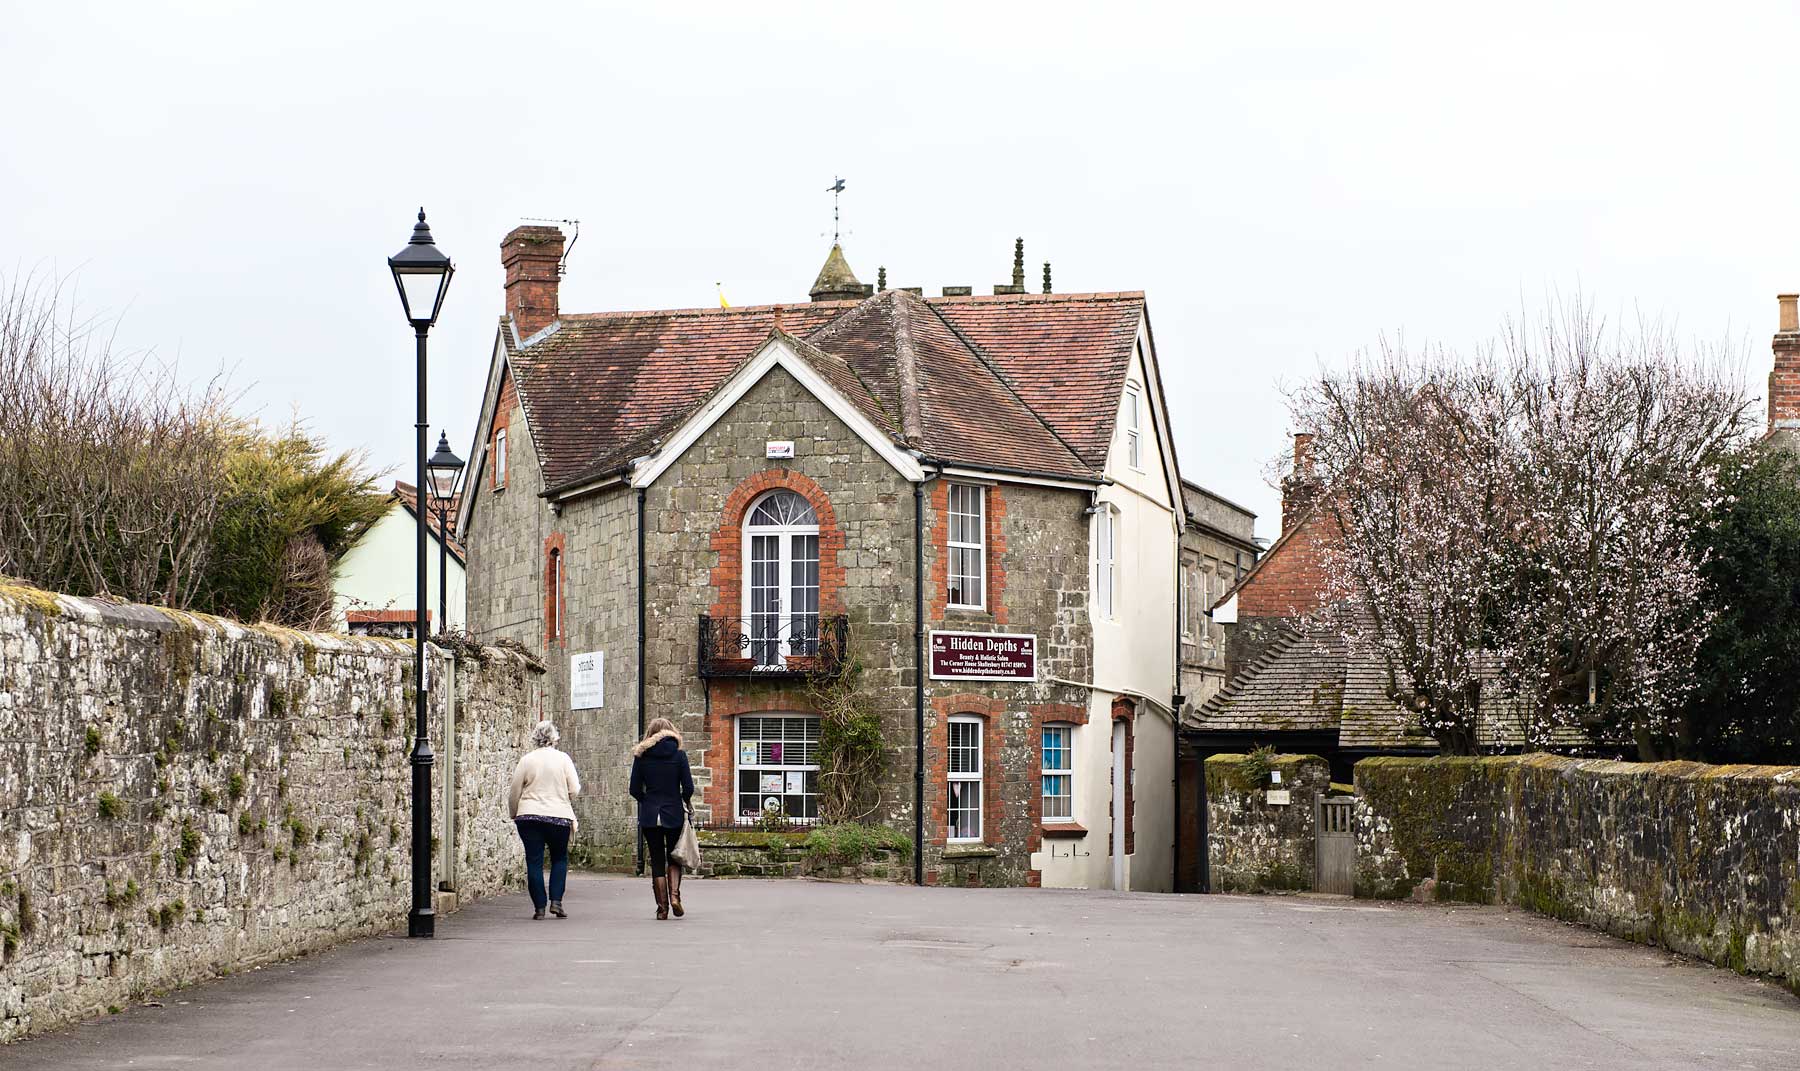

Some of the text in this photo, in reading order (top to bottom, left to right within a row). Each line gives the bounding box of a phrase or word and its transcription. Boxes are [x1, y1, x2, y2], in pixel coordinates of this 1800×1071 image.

[950, 637, 983, 651] Hidden
[987, 638, 1017, 654] Depths
[959, 653, 974, 661] Beauty
[977, 661, 1000, 669] Shaftesbury
